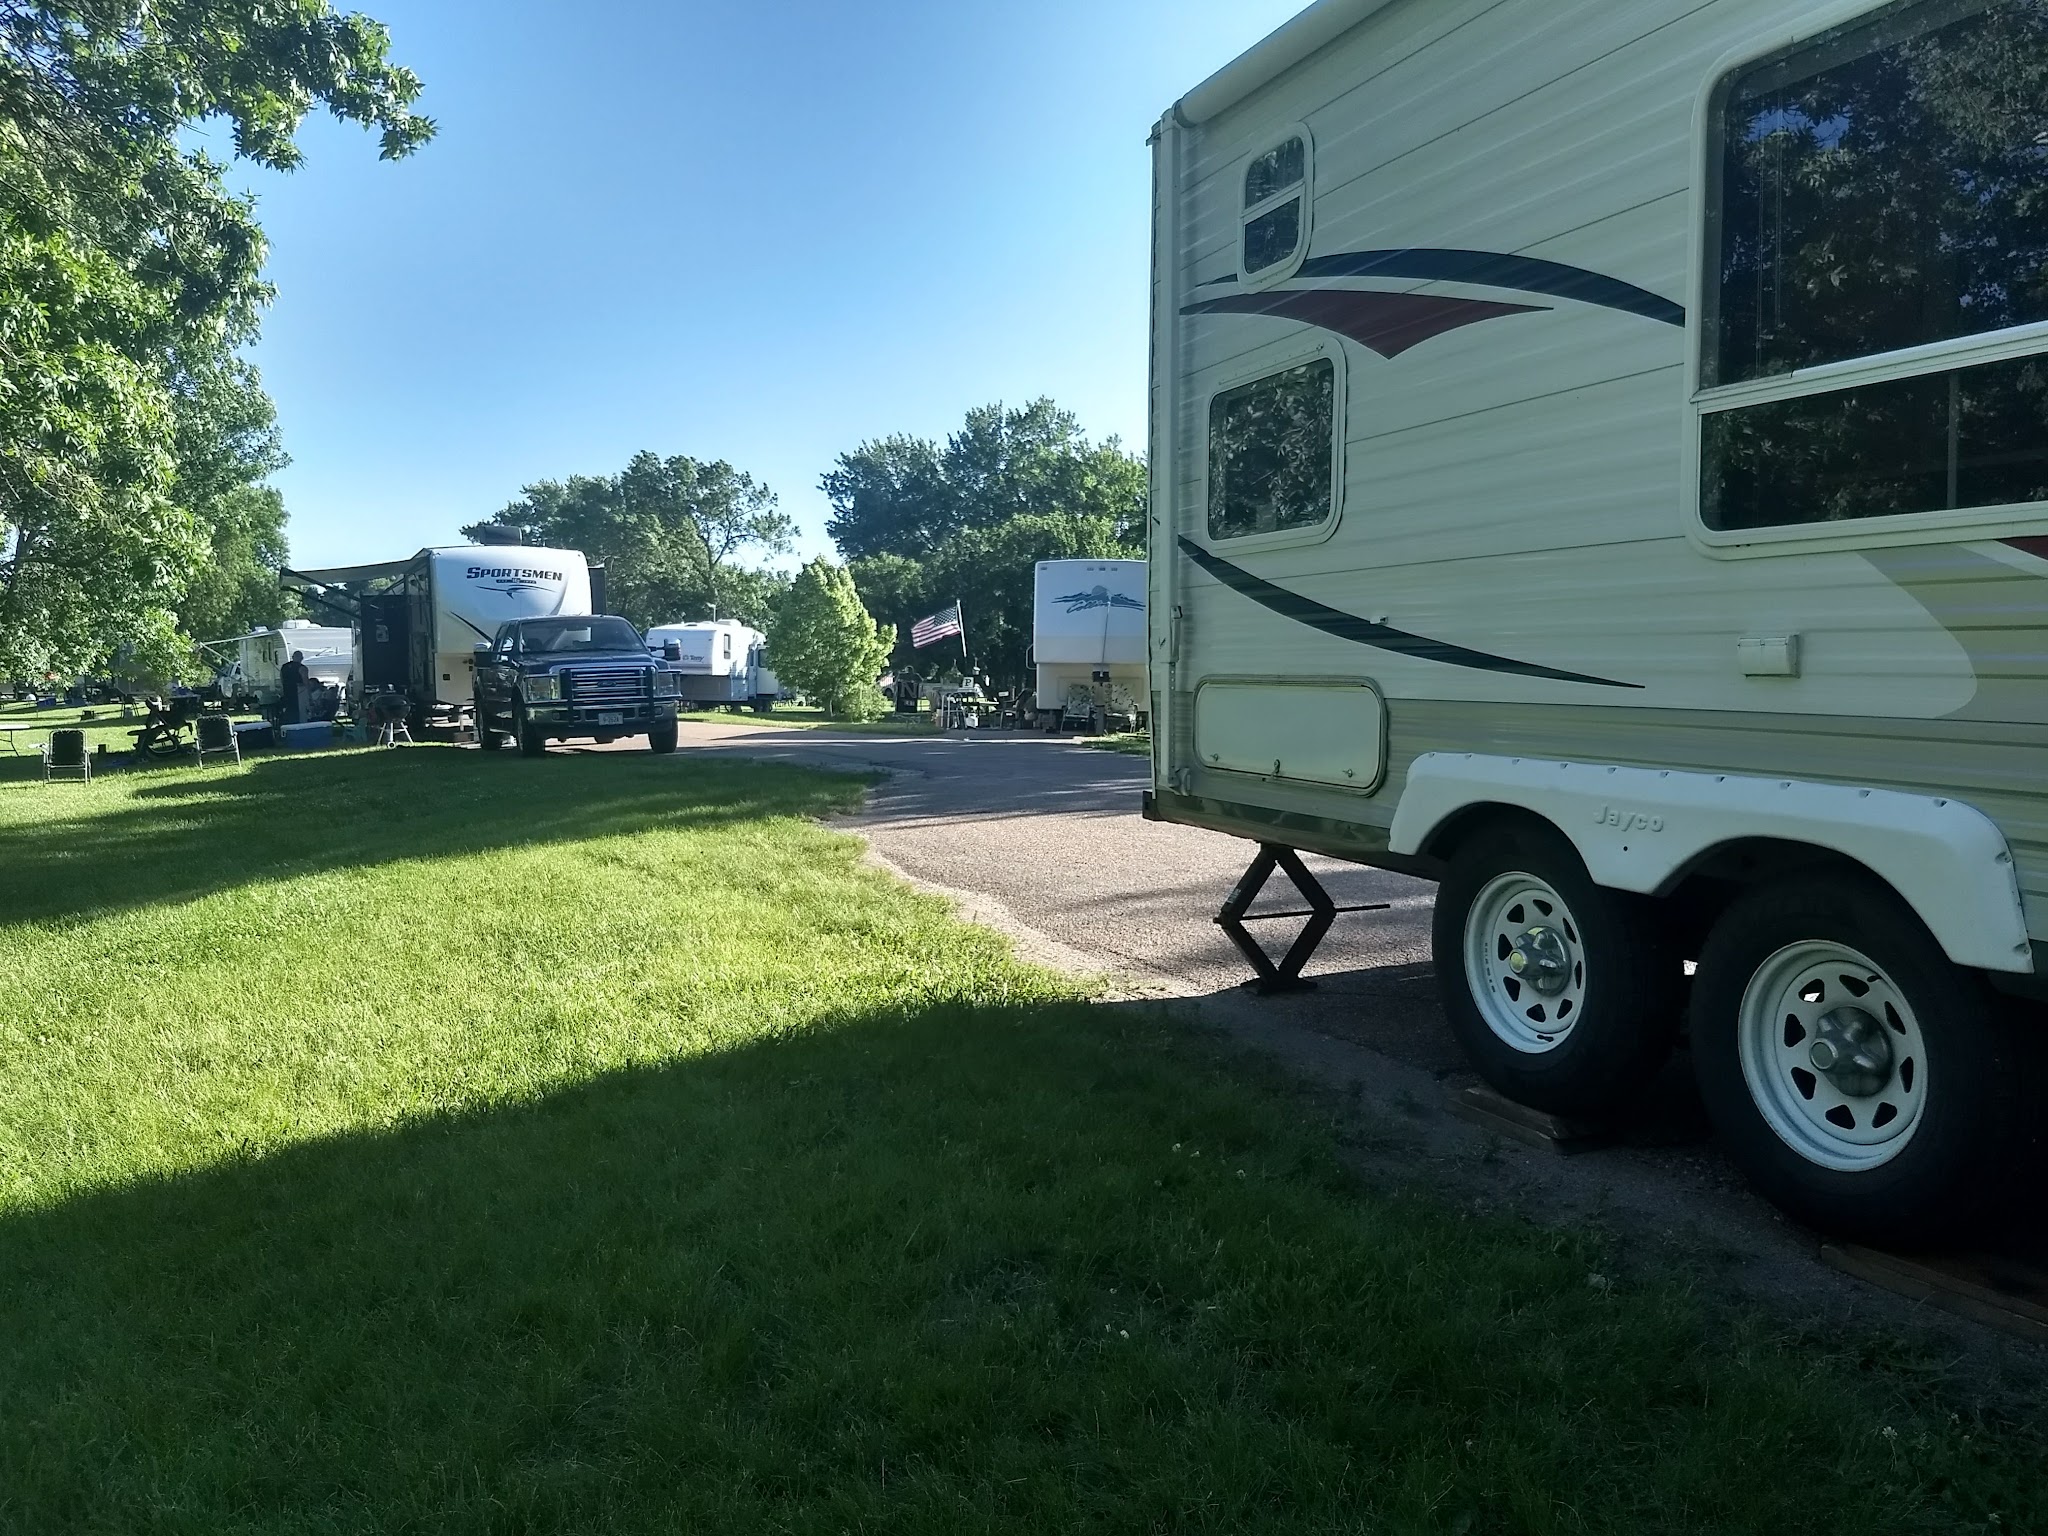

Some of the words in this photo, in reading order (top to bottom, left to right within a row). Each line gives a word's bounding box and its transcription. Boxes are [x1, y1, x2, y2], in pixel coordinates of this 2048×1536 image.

[467, 567, 562, 581] SPORTSMEN
[899, 681, 918, 698] N
[965, 678, 972, 687] P
[1593, 803, 1664, 832] Jayco
